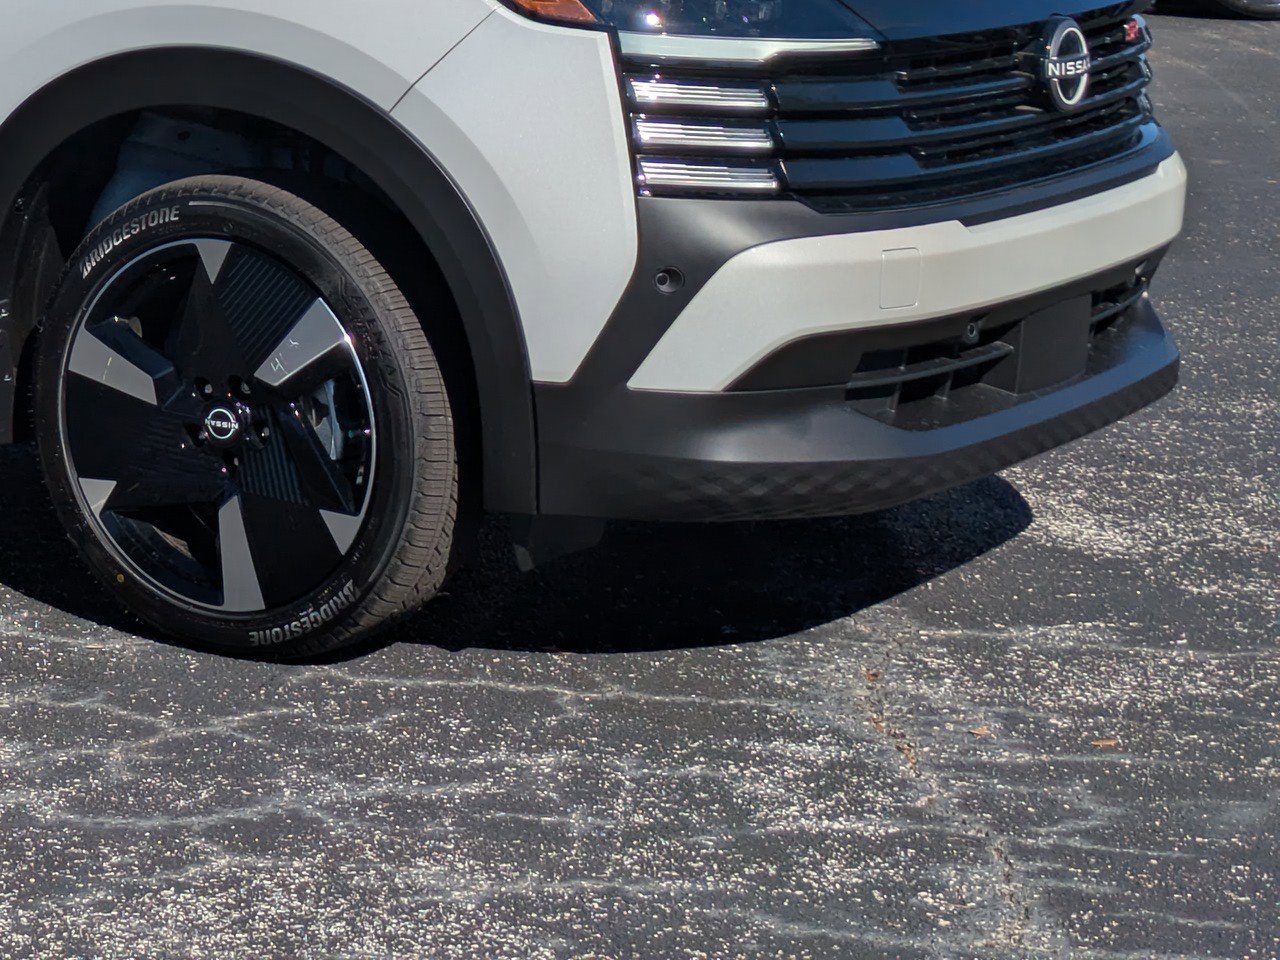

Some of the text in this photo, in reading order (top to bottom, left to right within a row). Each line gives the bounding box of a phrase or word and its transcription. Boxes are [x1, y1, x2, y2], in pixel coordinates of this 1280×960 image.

[1047, 59, 1091, 77] NISS
[80, 205, 181, 279] BRIDGESTONE
[248, 579, 360, 646] BRIDGESTONE
